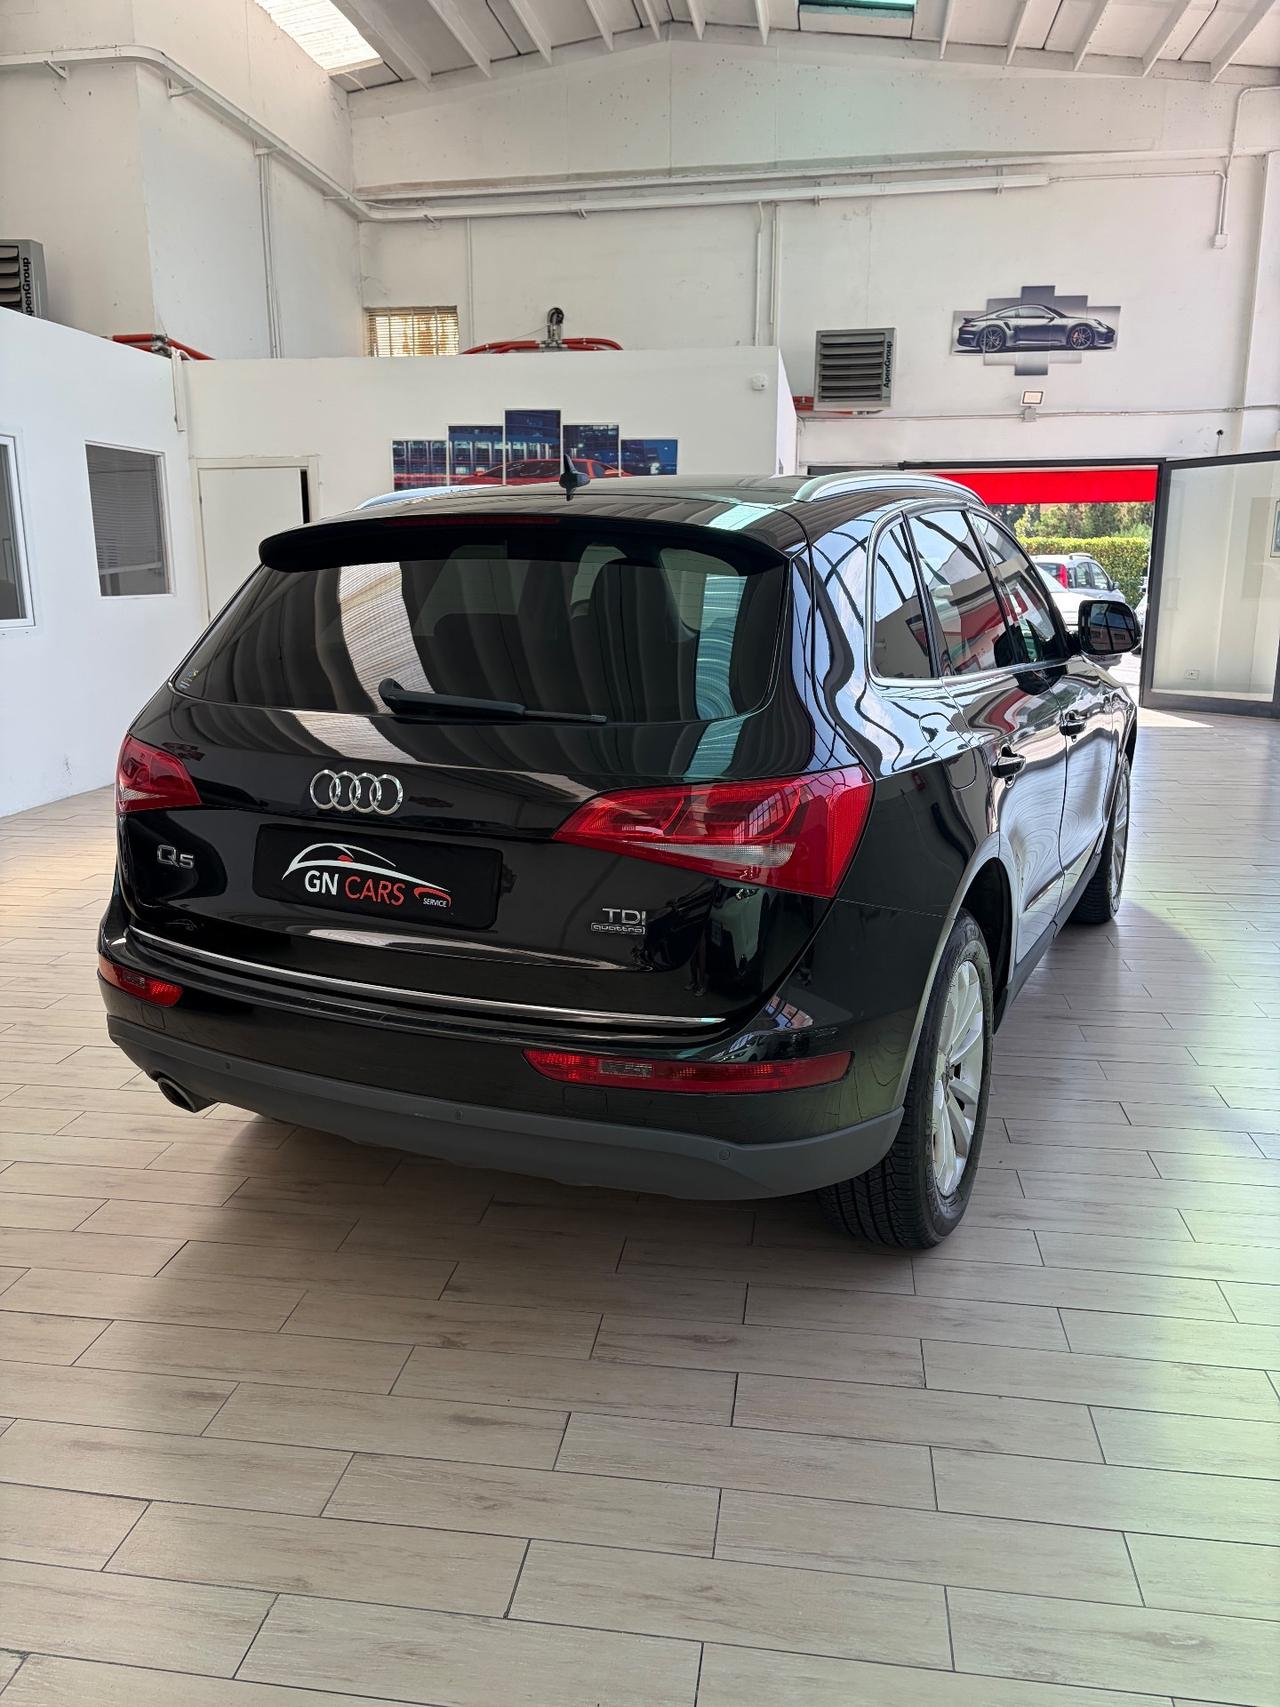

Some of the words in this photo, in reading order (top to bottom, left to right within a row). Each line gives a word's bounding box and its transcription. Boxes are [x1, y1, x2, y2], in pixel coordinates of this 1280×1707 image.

[883, 341, 893, 388] ApenGroup
[157, 844, 194, 869] Q5
[304, 870, 338, 895] GN
[345, 876, 405, 906] CARS
[423, 897, 447, 908] SERVICE
[602, 908, 646, 925] TDI
[593, 924, 642, 933] quattro
